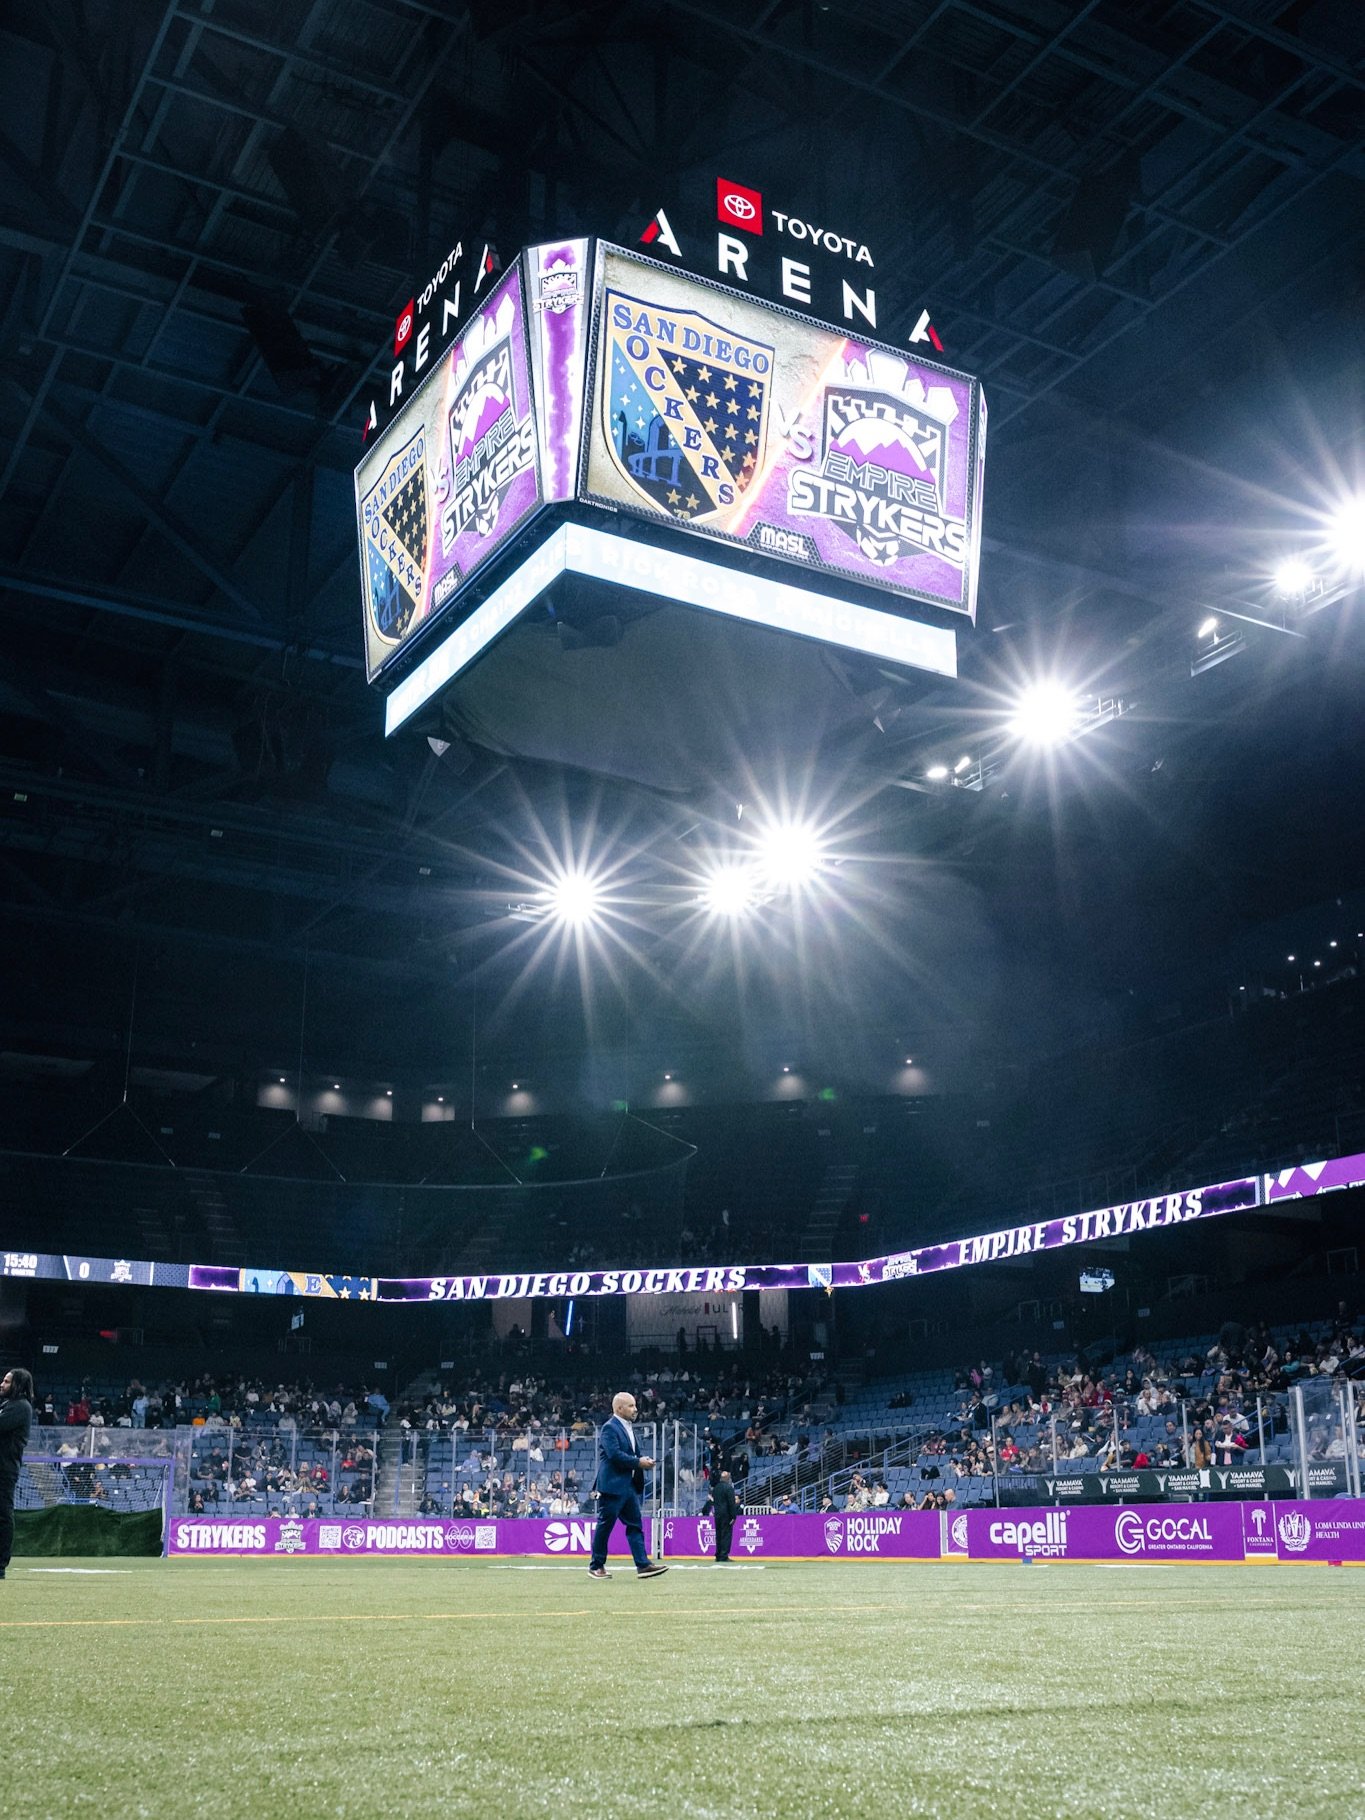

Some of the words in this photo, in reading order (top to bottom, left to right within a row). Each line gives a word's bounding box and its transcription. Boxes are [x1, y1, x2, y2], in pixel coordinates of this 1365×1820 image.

[772, 211, 875, 268] TOYOTA
[417, 241, 463, 314] TOYOTA
[640, 208, 944, 352] ARENA
[613, 303, 678, 344] SAN
[682, 326, 770, 374] DIEGO
[455, 407, 515, 491] EMPIRE
[773, 401, 814, 461] VS
[365, 484, 388, 525] SAN
[388, 437, 425, 493] DIEGO
[443, 414, 536, 546] STRYKERS
[824, 449, 939, 513] EMPIRE
[792, 473, 966, 559] STRYKERS
[760, 526, 810, 556] MASL
[958, 1223, 1048, 1265] EMPIRE
[1060, 1188, 1203, 1244] STRYKERS
[4, 1253, 38, 1268] 15:40
[79, 1262, 90, 1279] 0
[428, 1276, 488, 1300] SAN
[497, 1273, 591, 1297] DIEGO
[600, 1267, 748, 1293] SOCKERS
[176, 1524, 267, 1549] STRYKERS
[366, 1525, 444, 1549] PODCASTS
[846, 1517, 903, 1535] HOLLIDAY
[846, 1535, 880, 1552] ROCK
[989, 1511, 1068, 1553] capelli
[1146, 1518, 1213, 1540] GOCAL
[1315, 1531, 1340, 1539] HEALTH
[1333, 1521, 1352, 1529] LINDA
[1025, 1545, 1068, 1556] SPORT
